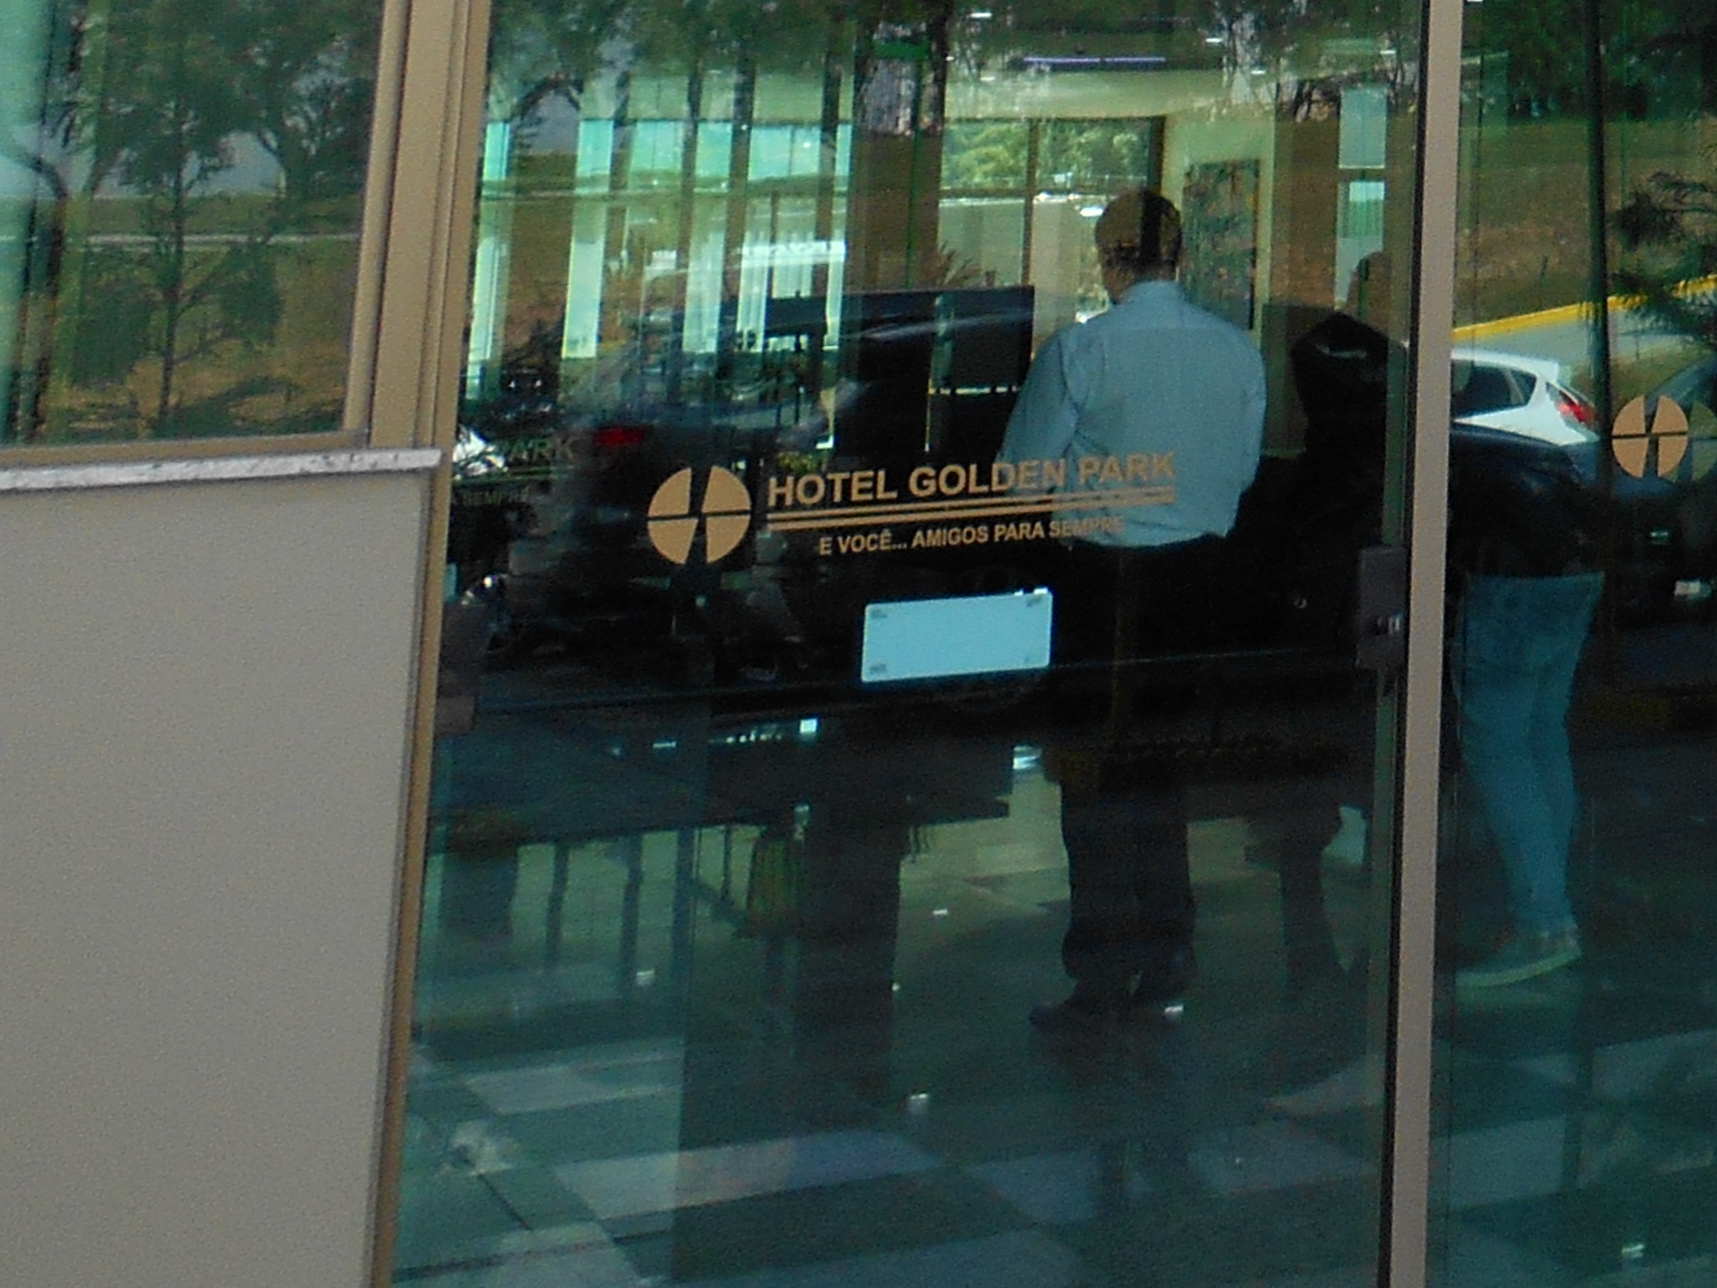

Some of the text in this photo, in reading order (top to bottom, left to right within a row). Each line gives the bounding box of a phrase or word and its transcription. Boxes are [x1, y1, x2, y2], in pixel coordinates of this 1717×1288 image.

[766, 451, 1176, 508] HOTEL GOLDEN PARK
[819, 515, 1124, 557] E VOCÊ... AMIGOS PARA SEMPRE
